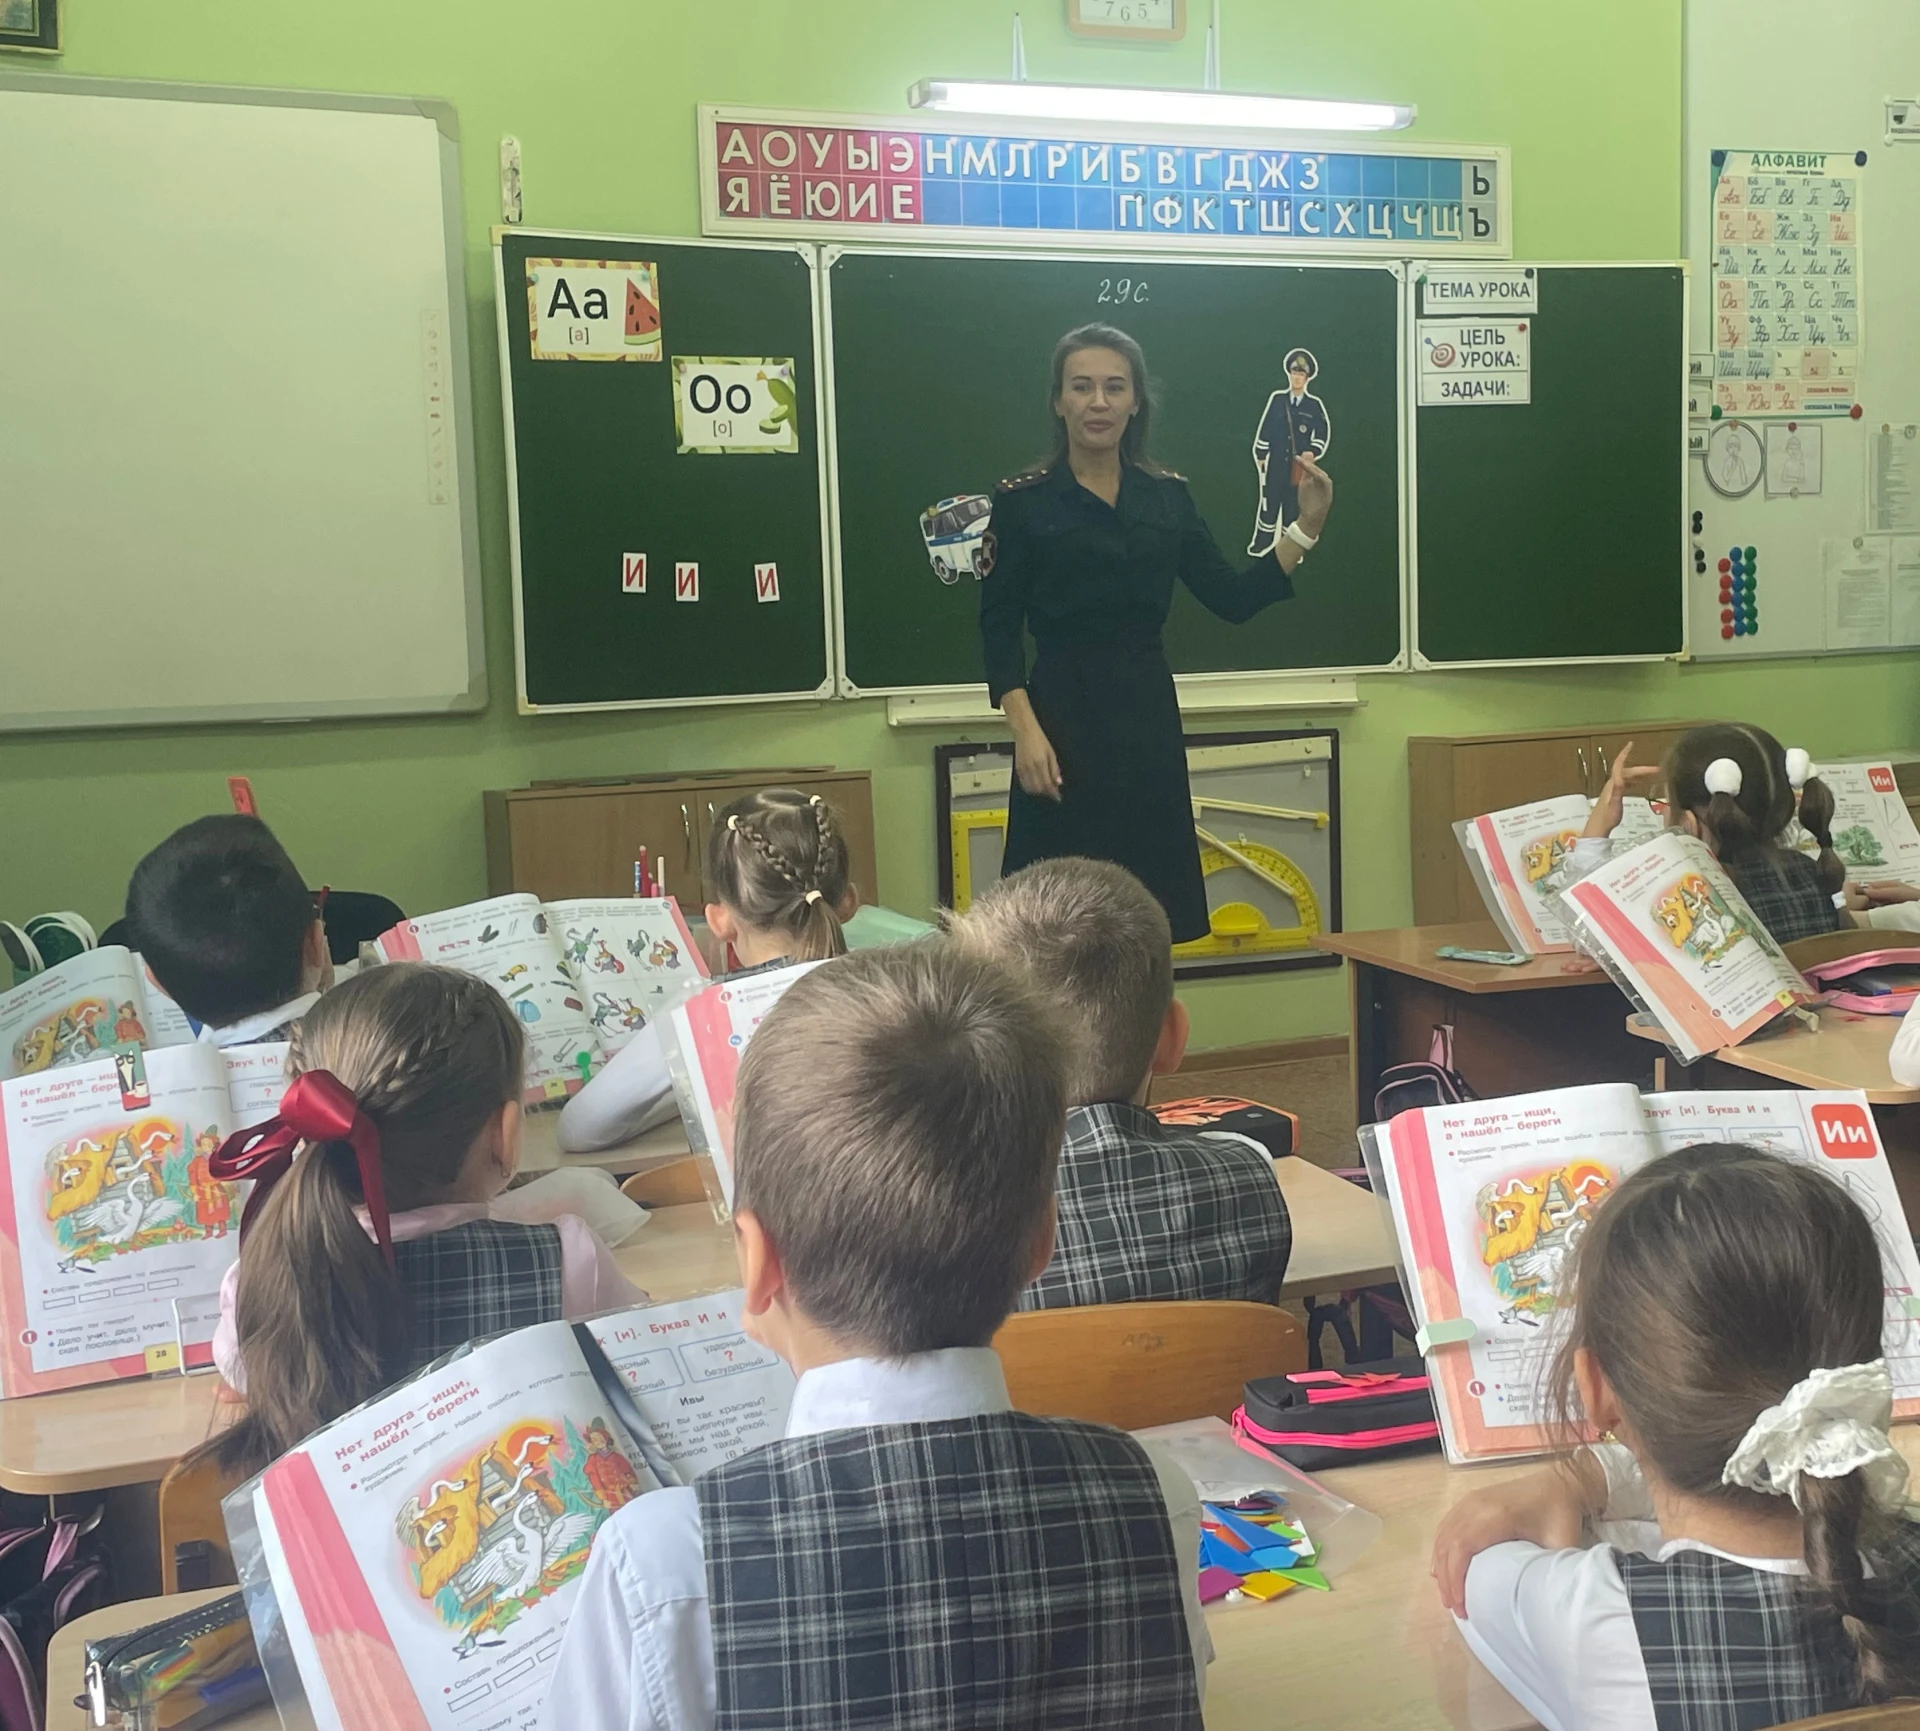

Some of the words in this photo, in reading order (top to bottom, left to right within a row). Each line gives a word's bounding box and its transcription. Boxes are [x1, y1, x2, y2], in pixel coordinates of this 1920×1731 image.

[1750, 154, 1828, 168] АЛФАВИТ
[547, 278, 608, 320] Аа
[1430, 282, 1475, 298] ТЕМА
[1478, 282, 1531, 298] УРОКА
[569, 327, 589, 345] [а]
[1460, 329, 1505, 349] ЦЕЛЬ
[1460, 351, 1520, 368] УРОКА:
[690, 375, 751, 414] Оо
[1441, 380, 1510, 400] ЗАДАЧИ:
[713, 420, 732, 438] [о]
[625, 558, 643, 588] И
[678, 568, 695, 597] И
[758, 568, 777, 597] И
[1871, 775, 1892, 787] Ии
[20, 1086, 42, 1098] Нет
[49, 1078, 84, 1093] друга
[36, 1090, 76, 1105] нашёл
[1442, 1119, 1466, 1129] Нет
[1474, 1113, 1509, 1126] друга
[1524, 1107, 1556, 1118] ищи,
[1644, 1109, 1673, 1119] Звук
[1707, 1105, 1741, 1117] Буква
[1446, 1133, 1453, 1141] а
[1460, 1127, 1502, 1139] нашёл
[1517, 1118, 1562, 1131] береги
[1821, 1120, 1868, 1144] Ии
[614, 1327, 642, 1343] [и].
[649, 1319, 690, 1335] Буква
[698, 1312, 709, 1324] И
[718, 1311, 727, 1319] и
[704, 1336, 746, 1354] ударный
[704, 1357, 764, 1377] безударный
[679, 1395, 705, 1407] Ивы
[335, 1439, 363, 1461] Нет
[374, 1410, 415, 1441] друга
[431, 1379, 471, 1403] ищи,
[650, 1420, 670, 1432] ему
[676, 1416, 690, 1426] вы
[696, 1410, 713, 1421] так
[719, 1396, 765, 1416] красивы?
[342, 1462, 351, 1473] а
[360, 1428, 410, 1462] нашёл
[426, 1387, 480, 1422] береги
[693, 1416, 738, 1433] шепнули
[689, 1436, 704, 1445] мы
[711, 1428, 731, 1439] над
[454, 1665, 492, 1690] Составь
[496, 1626, 556, 1667] предложение
